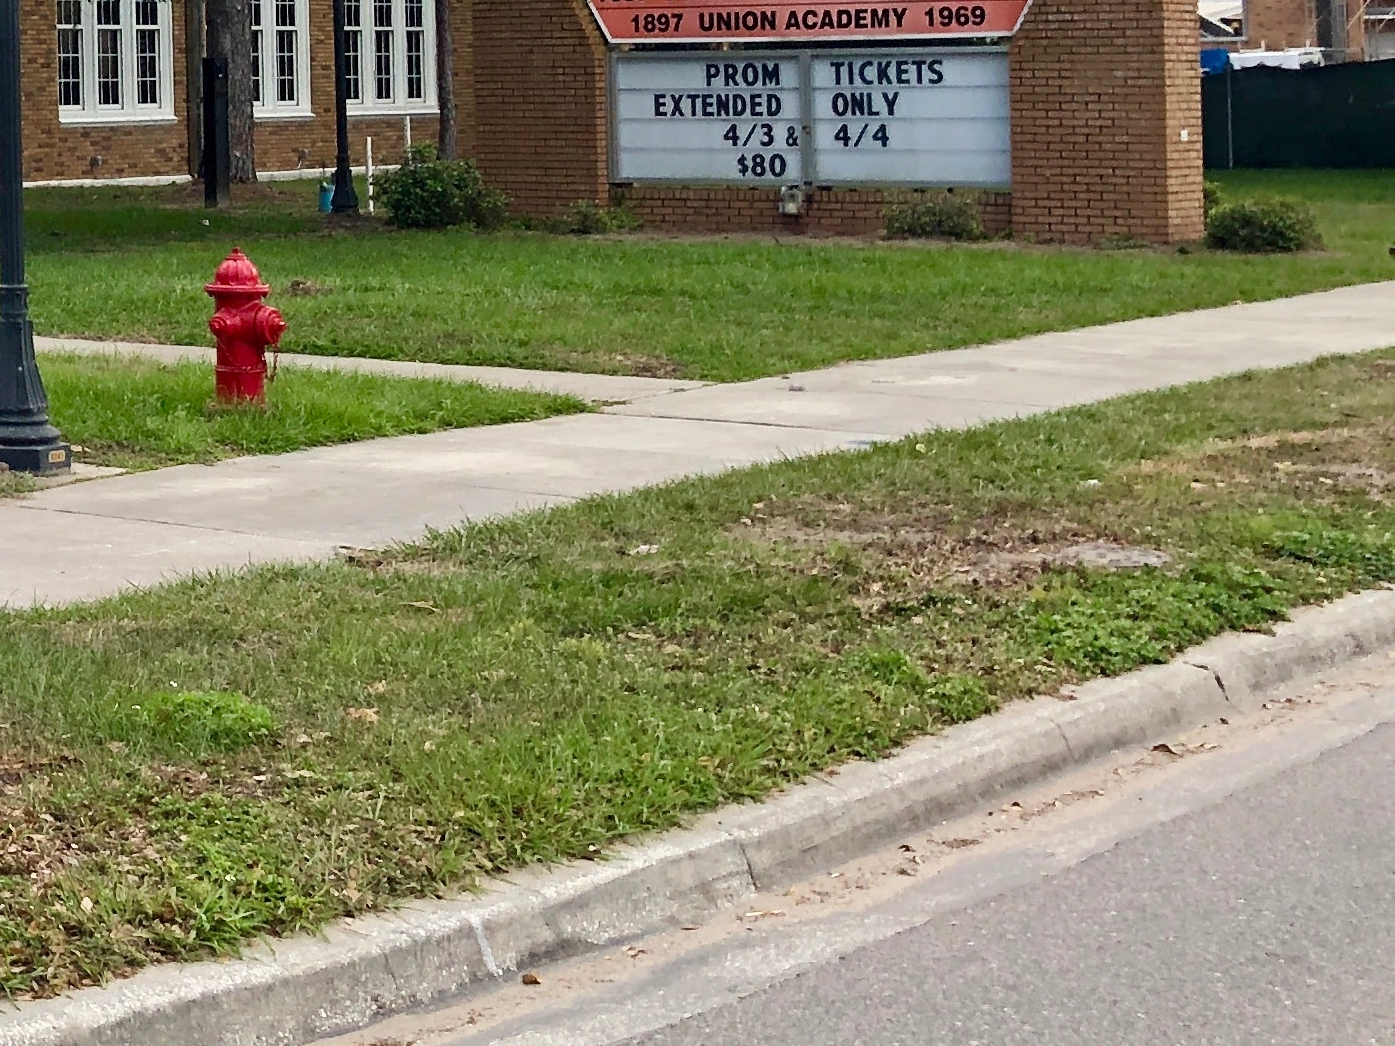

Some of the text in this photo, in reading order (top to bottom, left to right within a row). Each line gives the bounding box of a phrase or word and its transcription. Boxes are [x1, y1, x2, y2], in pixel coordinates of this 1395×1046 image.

[630, 6, 986, 33] 1897 UNION ACADEMY 1969
[705, 59, 944, 88] PROM TICKETS
[653, 91, 899, 118] EXTENDED ONLY
[723, 123, 889, 148] 4/3 & 4/4
[737, 153, 787, 179] $80
